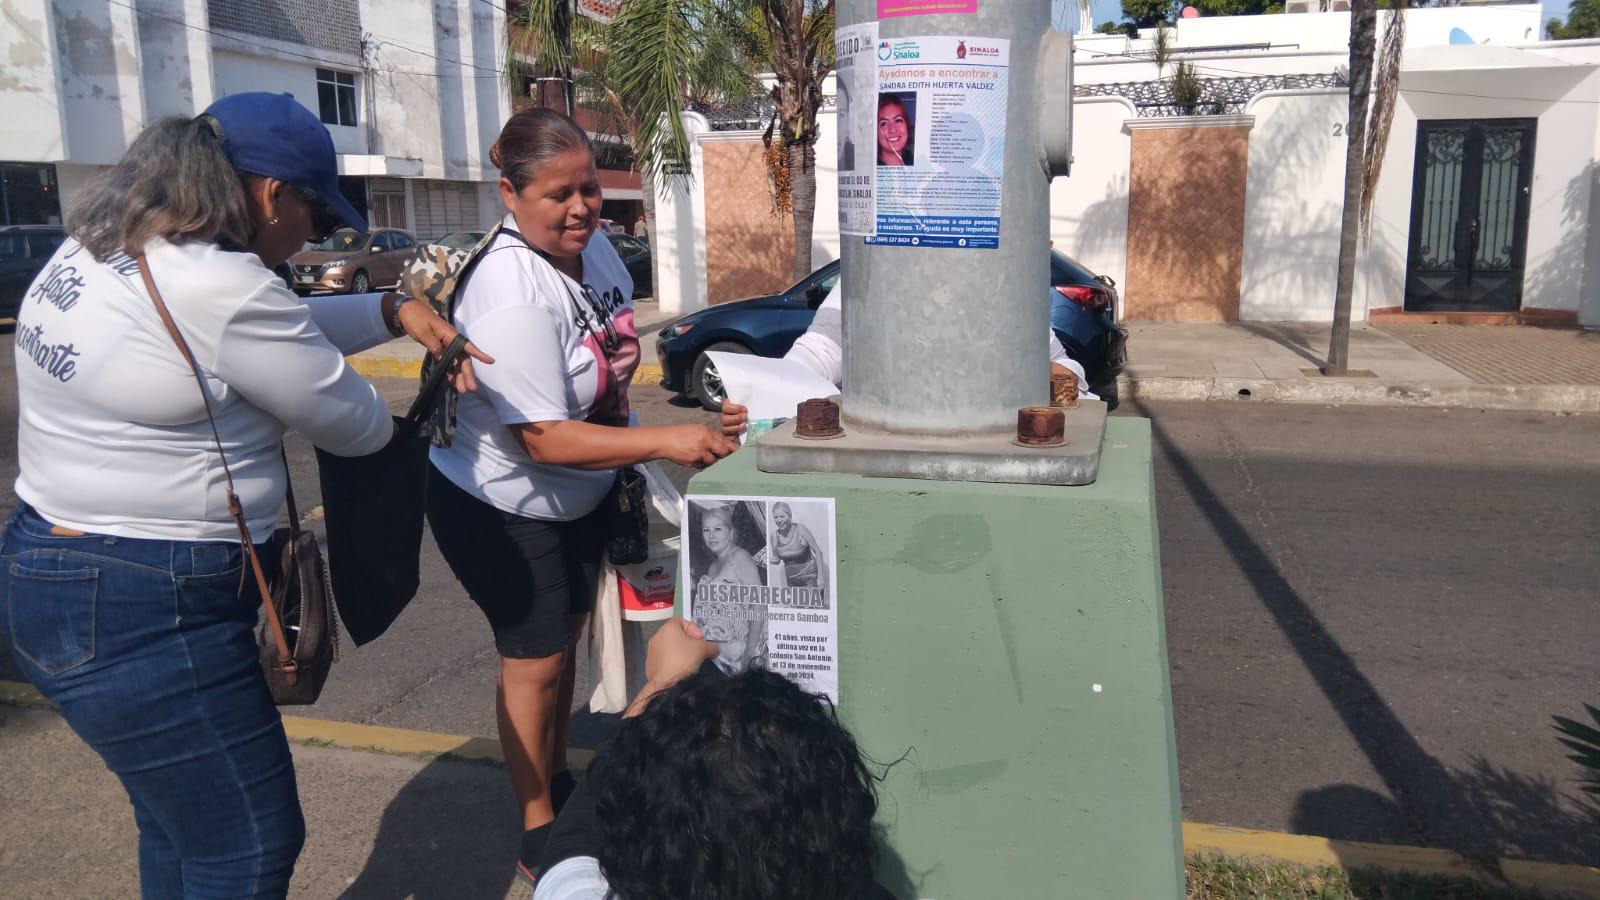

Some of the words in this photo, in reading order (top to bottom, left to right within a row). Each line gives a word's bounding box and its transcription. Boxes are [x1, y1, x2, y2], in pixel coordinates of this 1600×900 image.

[893, 51, 920, 61] Sinaloa
[929, 70, 935, 78] a
[939, 69, 991, 79] encontrar
[992, 72, 998, 80] a
[879, 83, 907, 91] SANDRA
[908, 82, 931, 90] EDITH
[932, 82, 964, 90] HUERTA
[31, 264, 86, 312] Hasta
[697, 583, 824, 607] DESAPARECIDA
[763, 611, 795, 622] Becerra
[797, 612, 829, 624] Gamboa
[774, 633, 782, 641] 41
[800, 634, 816, 642] vista
[769, 652, 793, 660] colonia
[787, 662, 796, 670] de
[797, 663, 831, 671] noviembre
